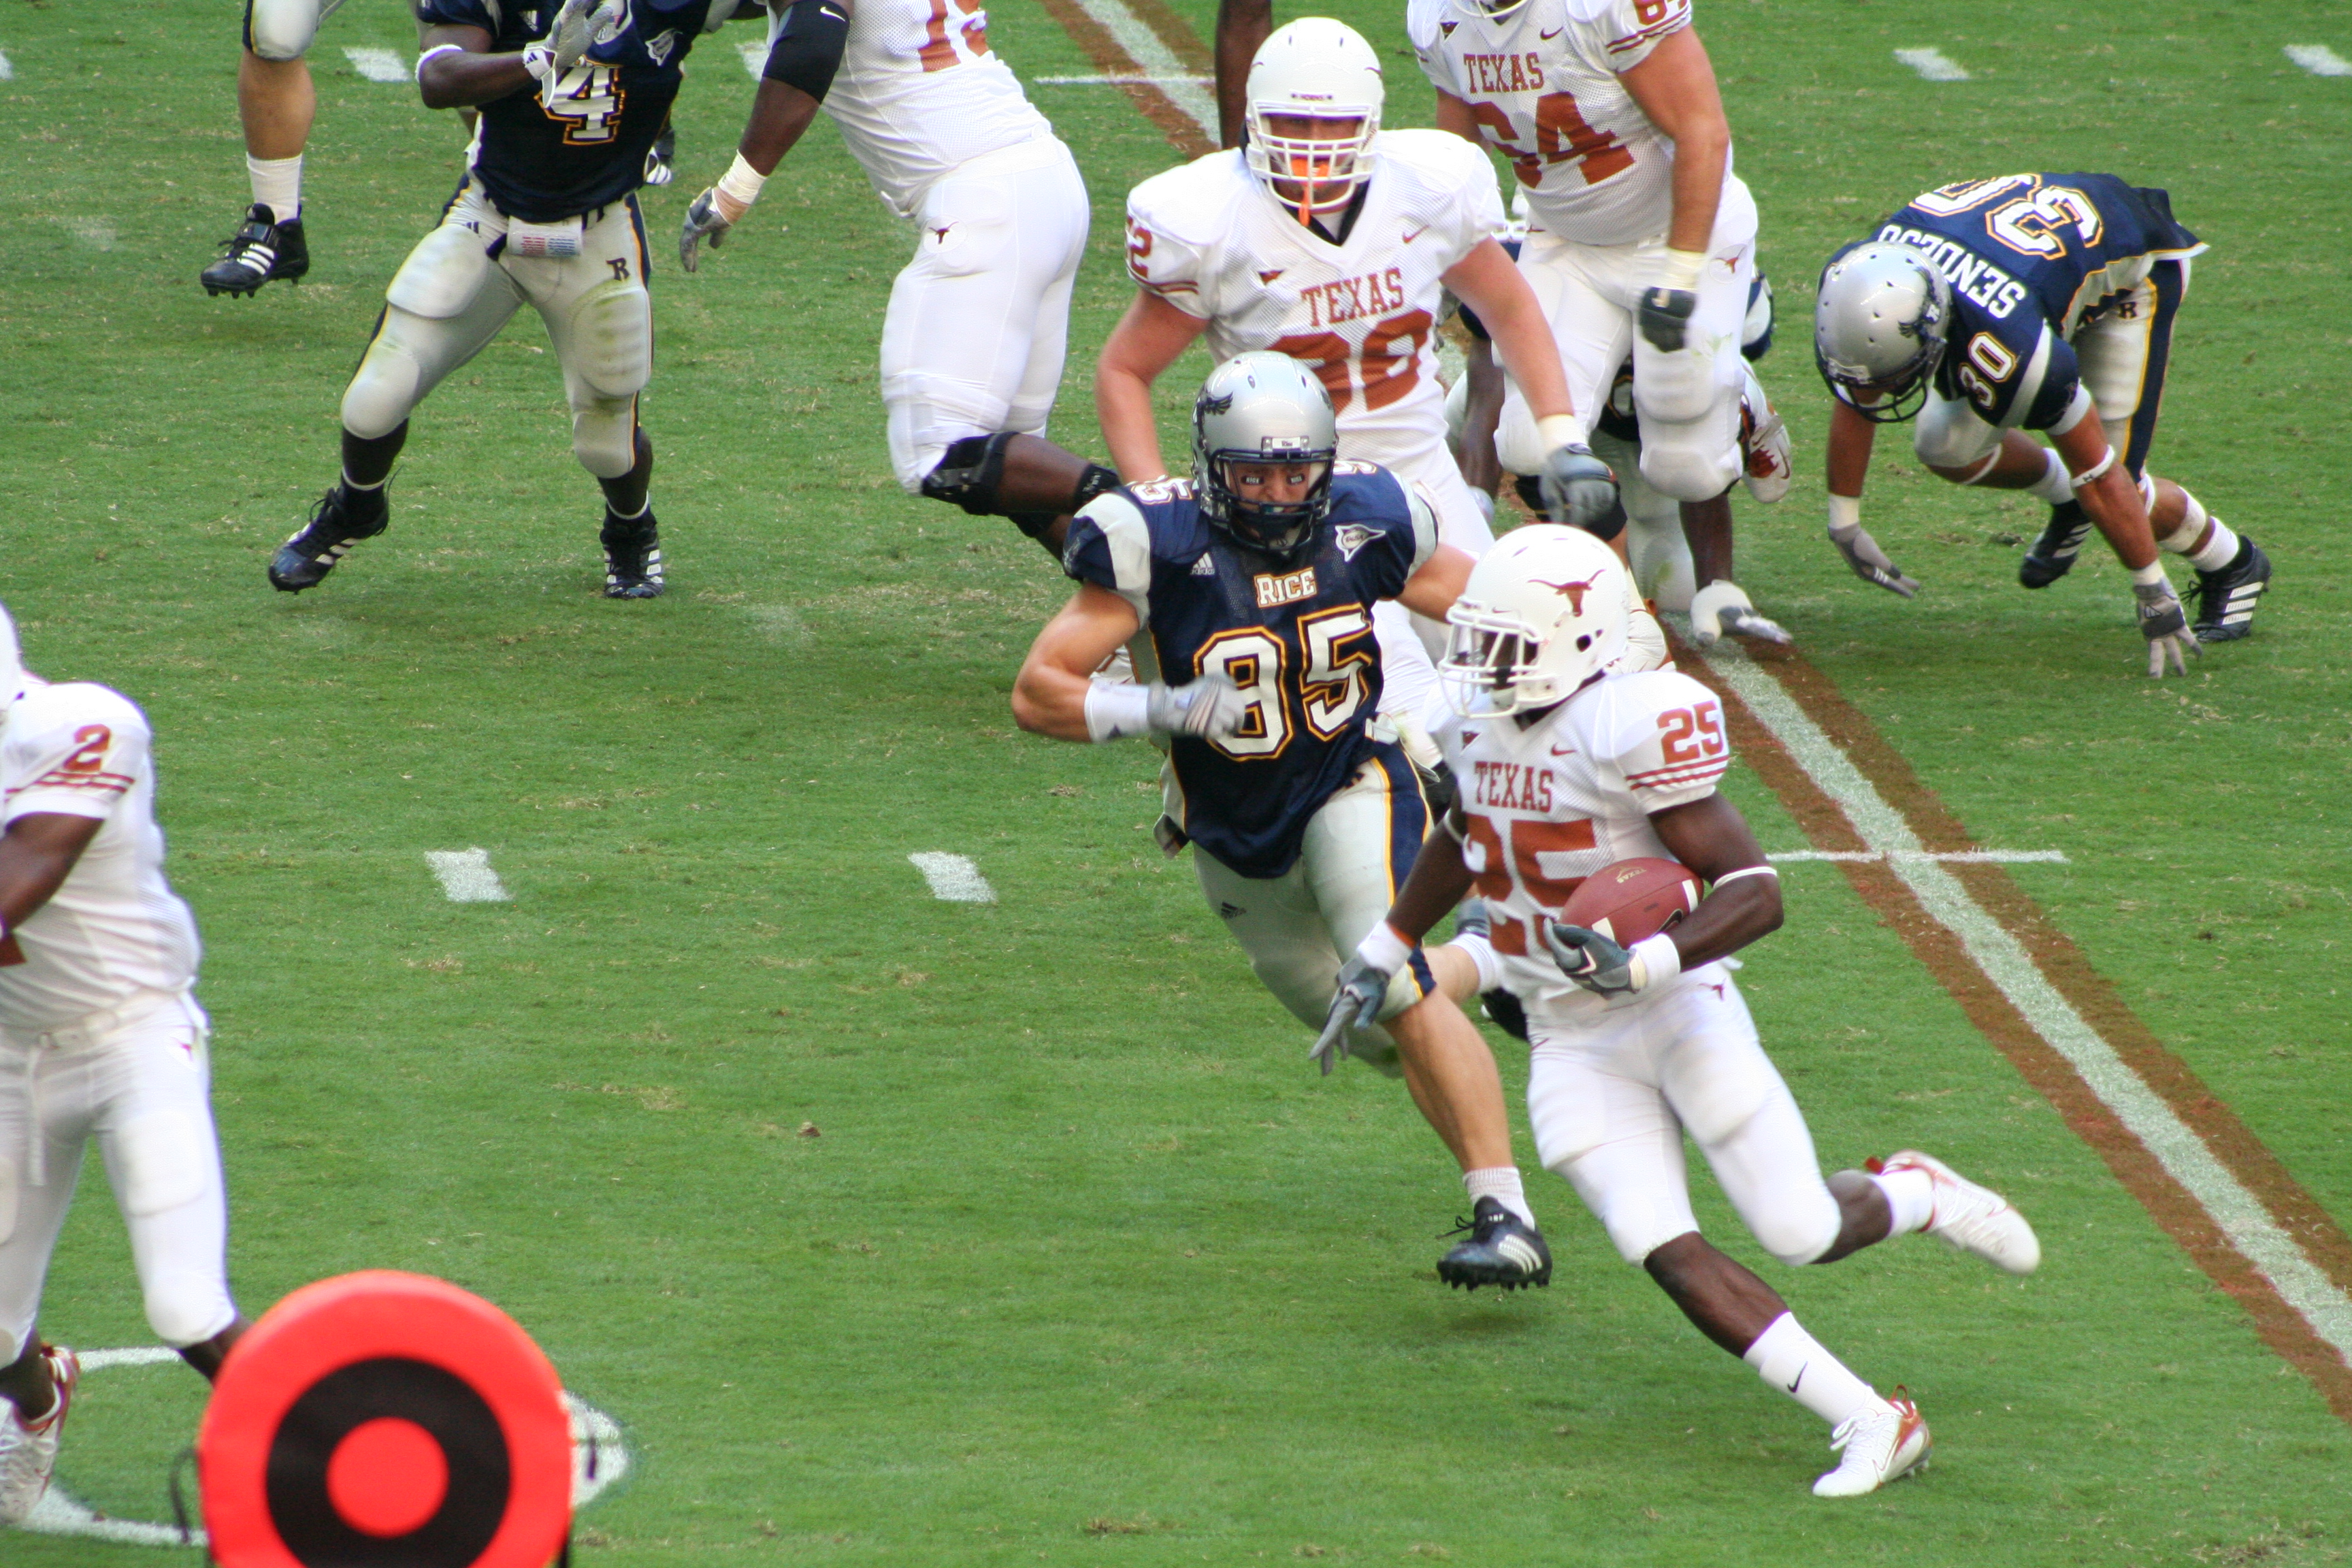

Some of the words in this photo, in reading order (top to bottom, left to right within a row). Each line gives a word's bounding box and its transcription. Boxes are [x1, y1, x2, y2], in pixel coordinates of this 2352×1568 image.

[1463, 52, 1544, 94] TEXAS
[1468, 91, 1635, 189] 64
[606, 257, 630, 280] R
[1300, 267, 1404, 327] TEXAS
[1958, 331, 2019, 410] 30
[1254, 566, 1318, 608] RICE
[63, 723, 112, 772] 2
[1656, 700, 1724, 765] 25
[1474, 760, 1554, 813] TEXAS
[1466, 813, 1597, 957] 25
[1616, 867, 1647, 884] TEXAS
